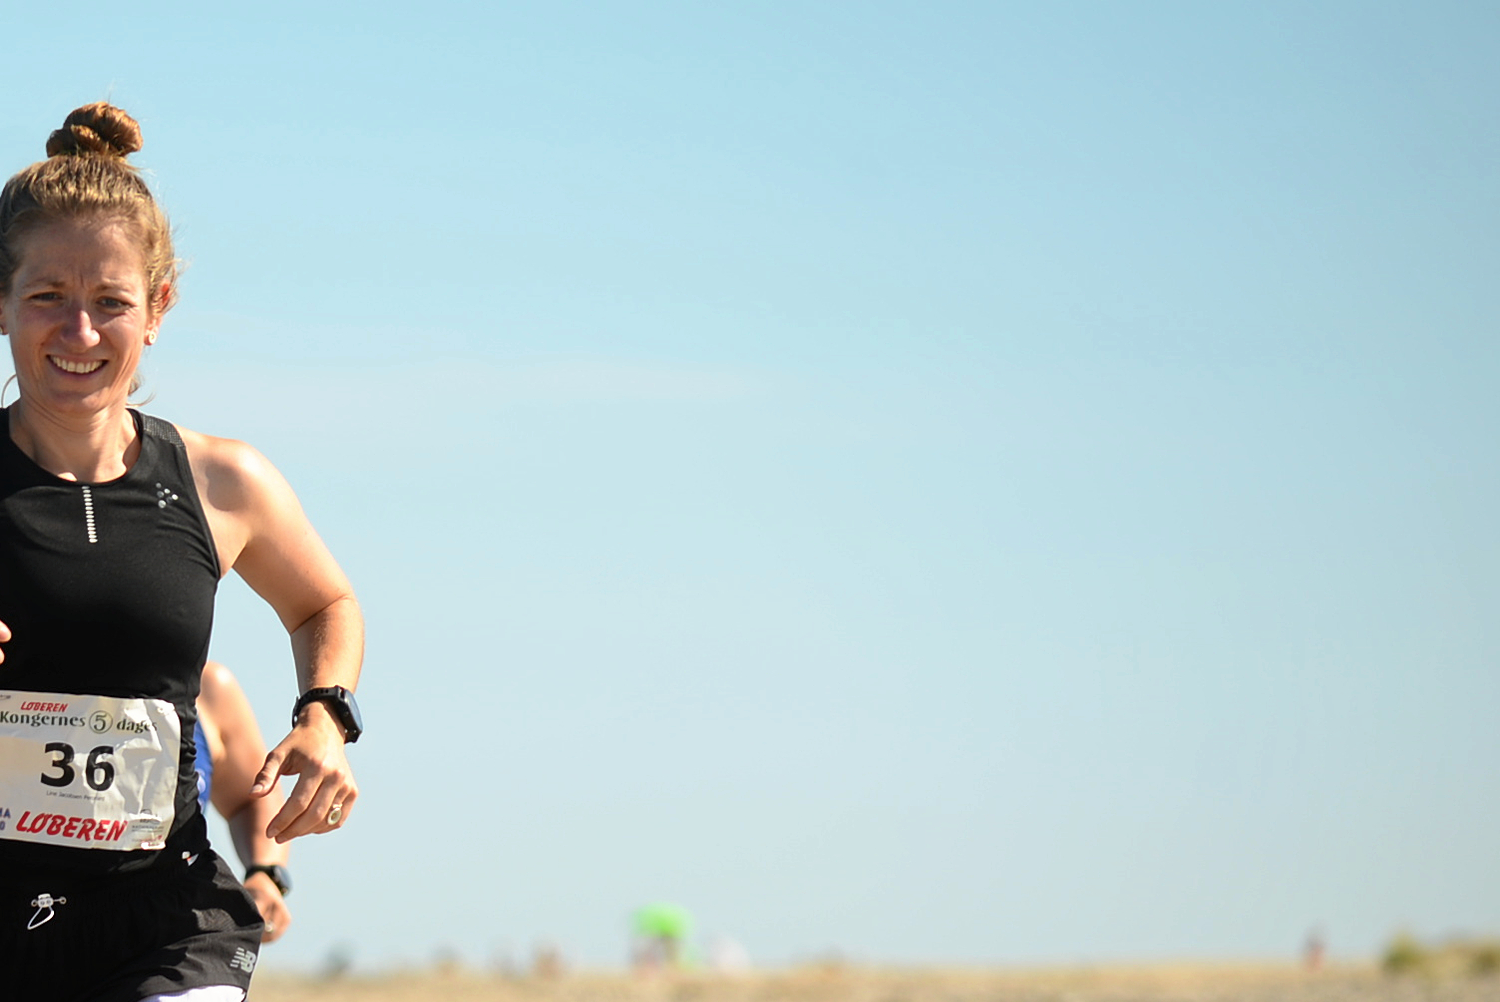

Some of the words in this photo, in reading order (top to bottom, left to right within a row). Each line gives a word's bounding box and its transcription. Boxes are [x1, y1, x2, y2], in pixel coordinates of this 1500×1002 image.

[20, 701, 69, 713] LØBEREN
[0, 711, 86, 728] Kongernes
[92, 712, 109, 732] 5
[40, 742, 115, 791] 36
[16, 811, 129, 842] LØBEREN
